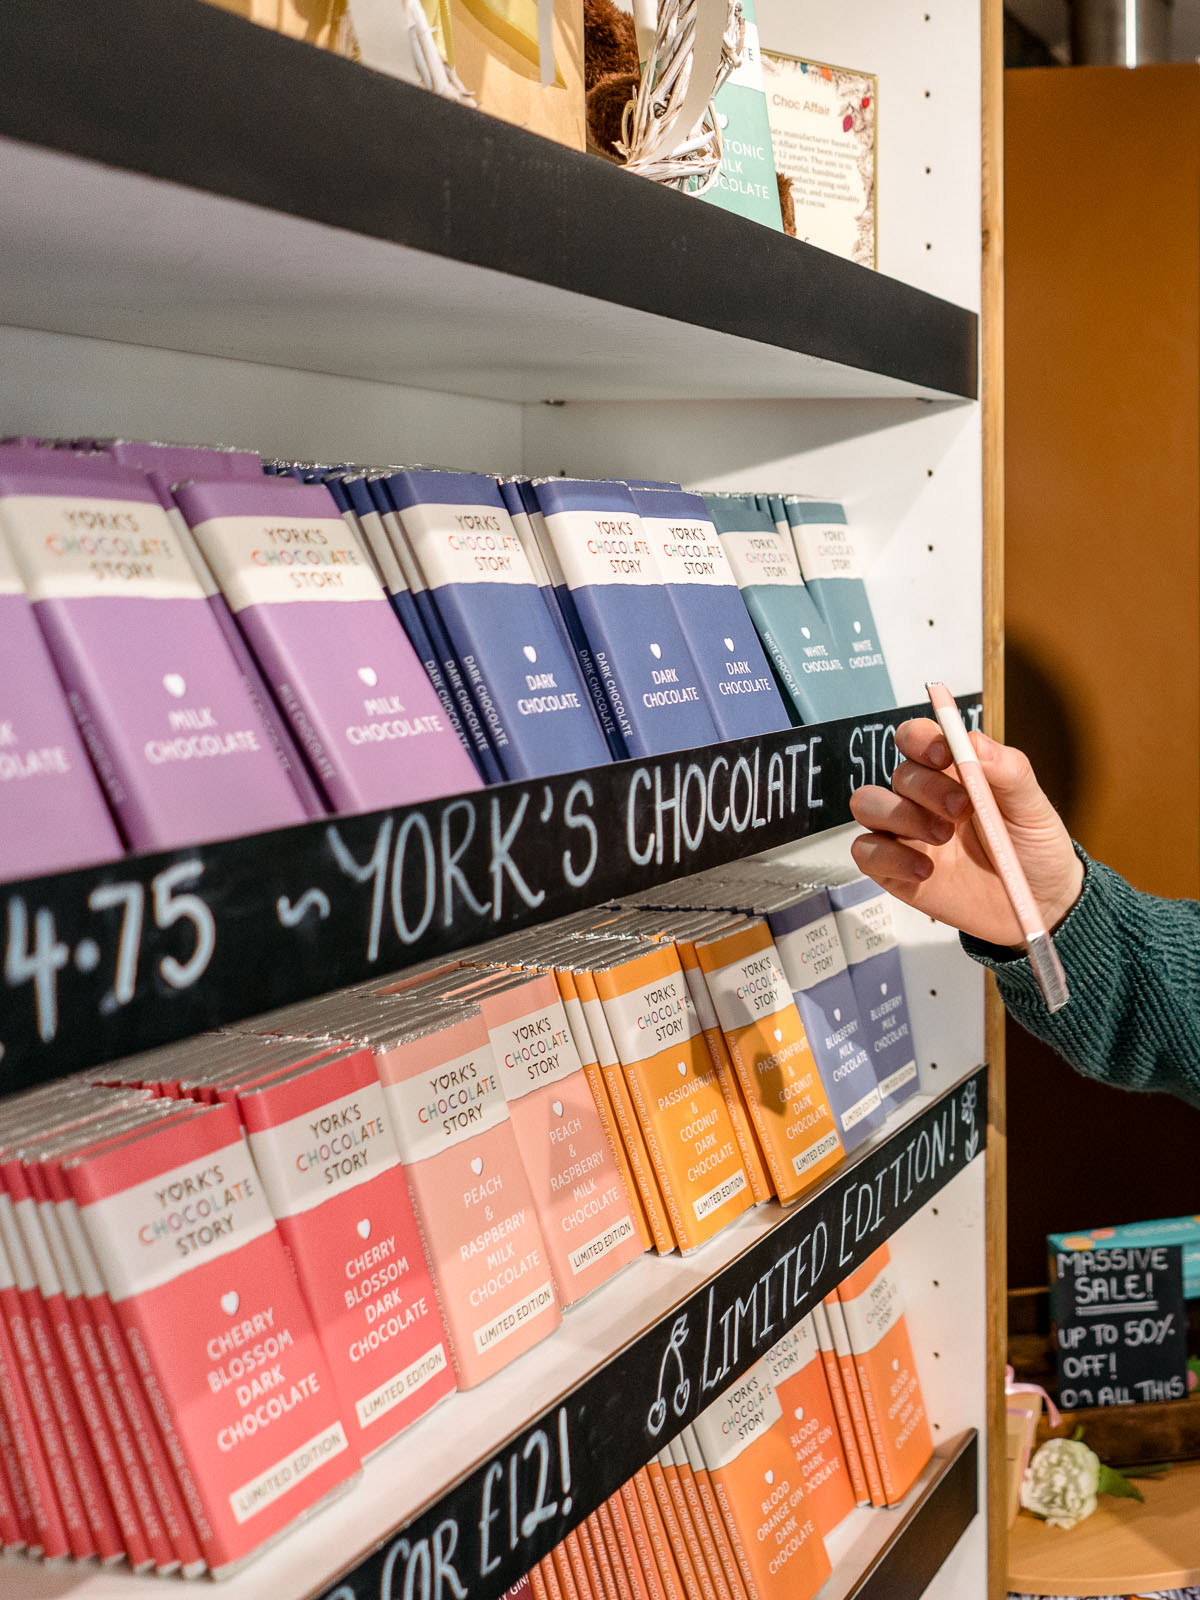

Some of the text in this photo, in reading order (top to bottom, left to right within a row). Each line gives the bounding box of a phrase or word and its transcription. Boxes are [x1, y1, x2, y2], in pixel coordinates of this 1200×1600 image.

[772, 94, 831, 116] Choc Affair
[724, 138, 766, 160] TONIC
[263, 527, 328, 547] YORK'S
[455, 515, 500, 532] YORK'S
[594, 520, 634, 536] YORK'S
[668, 527, 706, 541] YORK'S
[250, 548, 361, 568] CHOCOLATE
[448, 535, 521, 552] CHOCOLATE
[587, 540, 650, 555] CHOCOLATE
[663, 544, 723, 559] CHOCOLATE
[474, 556, 513, 571] STORY
[609, 559, 643, 574] STORY
[684, 562, 715, 576] STORY
[763, 566, 789, 577] STORY
[289, 570, 345, 589] STORY
[803, 645, 828, 658] WHITE
[850, 653, 884, 669] CHOCOLATE
[852, 639, 873, 652] WHITE
[652, 668, 679, 685] DARK
[725, 661, 752, 675] DARK
[763, 631, 801, 698] WHITE CHOCOLATE
[802, 659, 844, 674] CHOCOLATE
[525, 673, 558, 691] DARK
[596, 652, 633, 737] DARK CHOCOLATE
[643, 686, 700, 709] CHOCOLATE
[719, 678, 772, 696] CHOCOLATE
[363, 695, 406, 717] MILK
[463, 655, 509, 747] DARK CHOCOLATE
[517, 693, 581, 716] CHOCOLATE
[168, 707, 219, 733] MILK
[345, 715, 445, 746] CHOCOLATE
[144, 730, 261, 765] CHOCOLATE
[0, 723, 907, 1060] 4.75 YORK'S CHOCOLATE STO
[800, 936, 839, 964] CHOCOLATE
[805, 925, 828, 944] YORK'S
[741, 956, 772, 978] YORK'S
[814, 956, 834, 975] STORY
[643, 983, 676, 1006] YORK'S
[736, 967, 785, 1000] CHOCOLATE
[638, 995, 691, 1030] CHOCOLATE
[753, 989, 780, 1010] STORY
[512, 1017, 552, 1045] YORK'S
[655, 1018, 684, 1042] STORY
[825, 1018, 858, 1050] BLUEBERRY
[504, 1029, 569, 1070] CHOCOLATE
[756, 1036, 809, 1074] PASSIONFRUIT
[839, 1042, 855, 1060] MILK
[429, 1061, 477, 1096] YORK'S
[527, 1053, 560, 1081] STORY
[788, 1064, 795, 1077] &
[832, 1049, 869, 1083] CHOCOLATE
[417, 1074, 497, 1125] CHOCOLATE
[657, 1069, 716, 1111] PASSIONFRUIT
[779, 1073, 814, 1103] COCONUT
[442, 1102, 484, 1137] STORY
[691, 1101, 698, 1114] &
[792, 1095, 813, 1116] DARK
[309, 1103, 362, 1141] YORK'S
[548, 1117, 582, 1146] PEACH
[680, 1108, 719, 1142] COCONUT
[786, 1104, 828, 1141] CHOCOLATE
[295, 1118, 385, 1173] CHOCOLATE
[568, 1143, 577, 1158] &
[606, 1070, 666, 1246] PASSIONFRUIT COCONUT DARK CHOCOLATE
[694, 1132, 718, 1155] DARK
[795, 1134, 838, 1171] LIMITED EDITION
[324, 1148, 369, 1185] STORY
[550, 1149, 605, 1193] RASPBERRY
[687, 1142, 735, 1182] CHOCOLATE
[154, 1164, 225, 1209] YORK'S
[462, 1175, 503, 1209] PEACH
[572, 1178, 598, 1202] MILK
[697, 1175, 744, 1215] LIMITED EDITION
[138, 1176, 254, 1246] CHOCOLATE
[484, 1205, 494, 1222] &
[561, 1186, 620, 1233] CHOCOLATE
[176, 1212, 235, 1258] STORY
[460, 1209, 526, 1262] RASPBERRY
[573, 1222, 631, 1269] LIMITED EDITION
[701, 1098, 956, 1392] LIMITED EDITION!
[344, 1236, 398, 1282] CHERRY
[487, 1242, 515, 1272] MILK
[1057, 1247, 1168, 1278] MASSIVE
[344, 1256, 410, 1310] BLOSSOM
[469, 1250, 541, 1308] CHOCOLATE
[1075, 1272, 1154, 1304] SALE!
[365, 1286, 403, 1325] DARK
[479, 1289, 551, 1346] LIMITED EDITION
[206, 1307, 275, 1362] CHERRY
[349, 1298, 429, 1364] CHOCOLATE
[1058, 1313, 1175, 1349] UP TO 50%
[207, 1330, 295, 1395] BLOSSOM
[773, 1350, 800, 1378] STORY
[1063, 1352, 1118, 1380] OFF!
[237, 1364, 286, 1408] DARK
[361, 1353, 443, 1418] LIMITED EDITION
[727, 1376, 759, 1409] YORK'S
[1098, 1386, 1136, 1406] ALL
[1134, 1375, 1185, 1403] THIS
[216, 1373, 322, 1453] CHOCOLATE
[721, 1383, 772, 1435] CHOCOLATE
[738, 1409, 765, 1440] STORY
[789, 1418, 820, 1448] BLOOD
[818, 1426, 833, 1447] GIN
[237, 1430, 342, 1515] LIMITED EDITION
[802, 1458, 826, 1478] DARK
[479, 1406, 572, 1577] £12!
[760, 1480, 790, 1515] BLOOD
[757, 1487, 804, 1542] ORANGE GIN
[715, 1483, 752, 1581] BLOOD ORANGE GIN DARK
[774, 1516, 798, 1545] DARK
[768, 1519, 815, 1575] CHOCOLATE
[510, 1573, 530, 1597] GIN!
